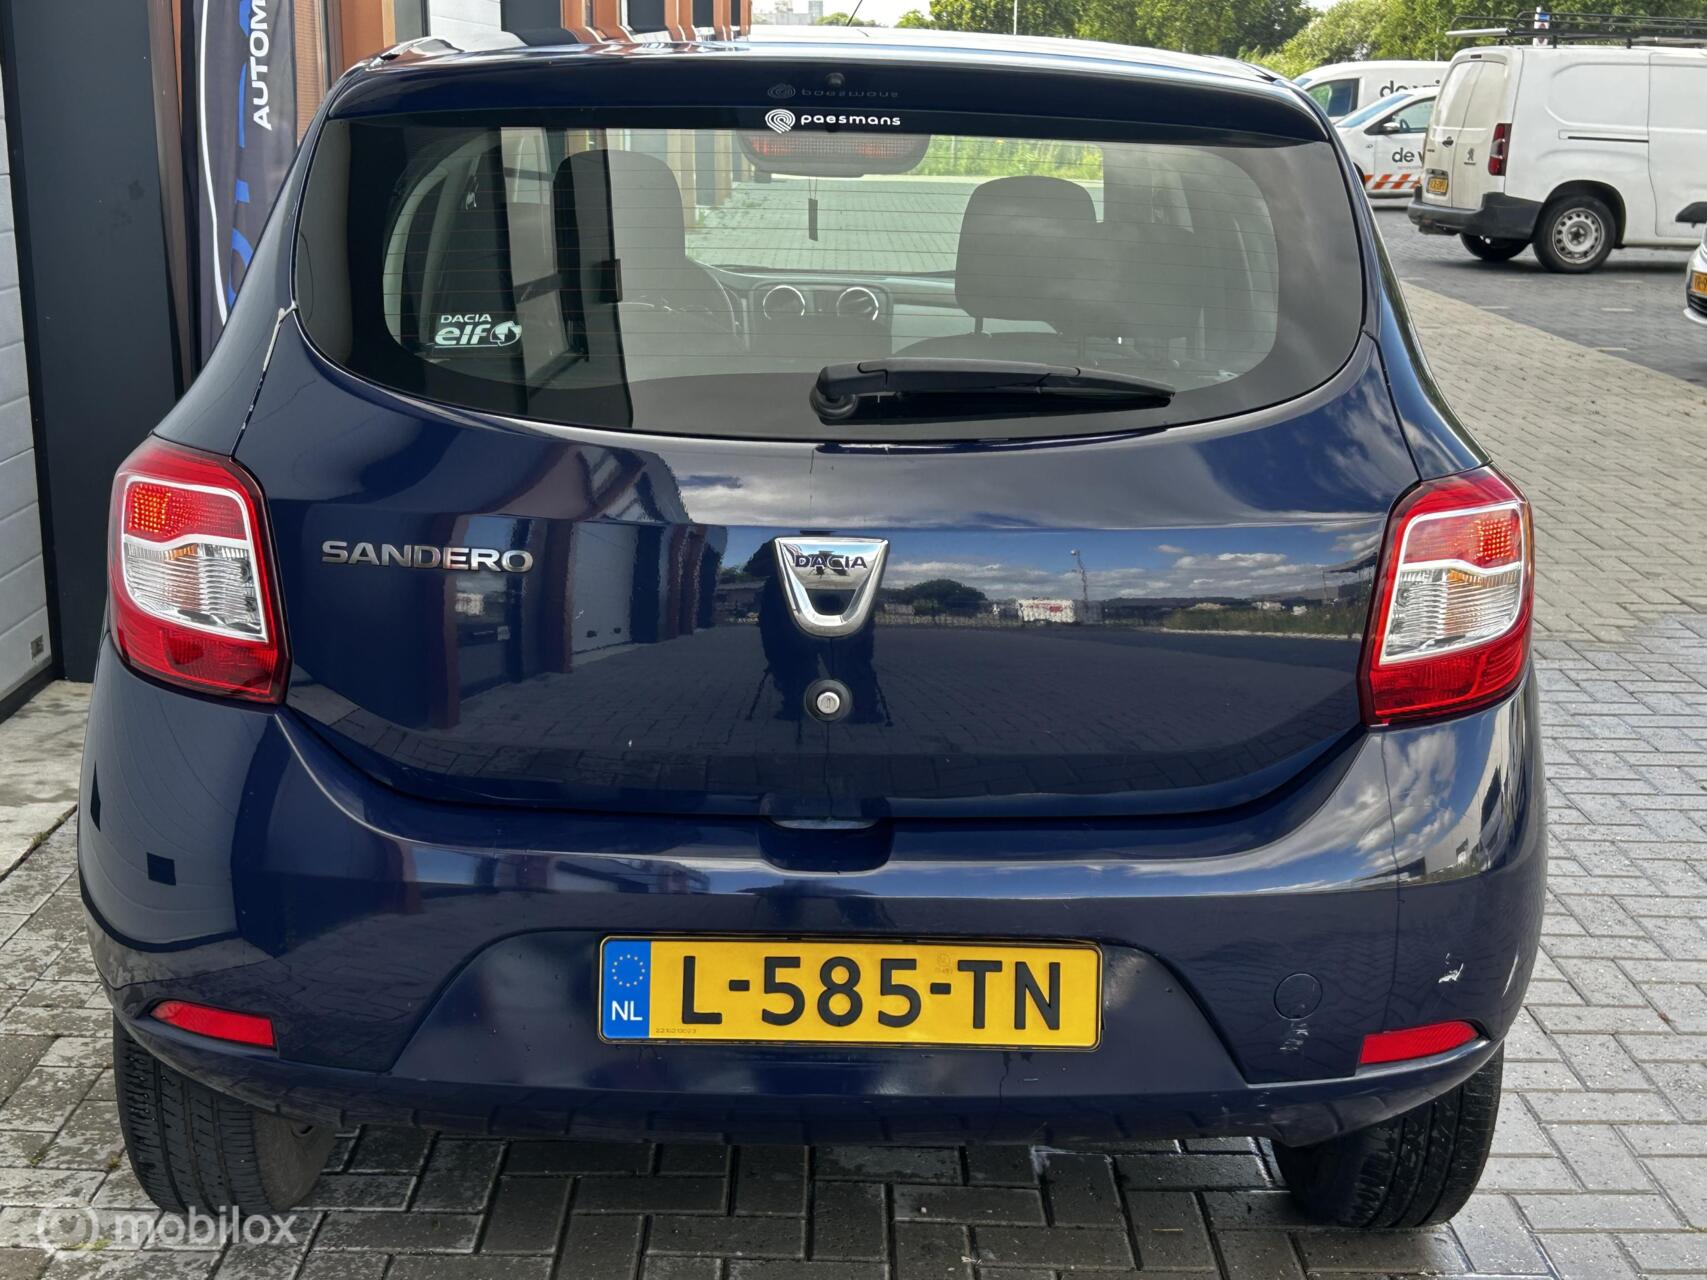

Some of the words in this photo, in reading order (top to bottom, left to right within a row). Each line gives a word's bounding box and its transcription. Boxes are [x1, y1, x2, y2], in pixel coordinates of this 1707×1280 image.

[250, 0, 272, 131] AUTOM
[801, 114, 901, 126] paesmans
[1391, 147, 1415, 163] de
[440, 314, 492, 323] DACIA
[435, 324, 491, 345] elf
[321, 540, 534, 573] SANDERO
[795, 554, 868, 569] DACIA
[681, 955, 1061, 1031] L-585-TN
[612, 1000, 643, 1021] NL
